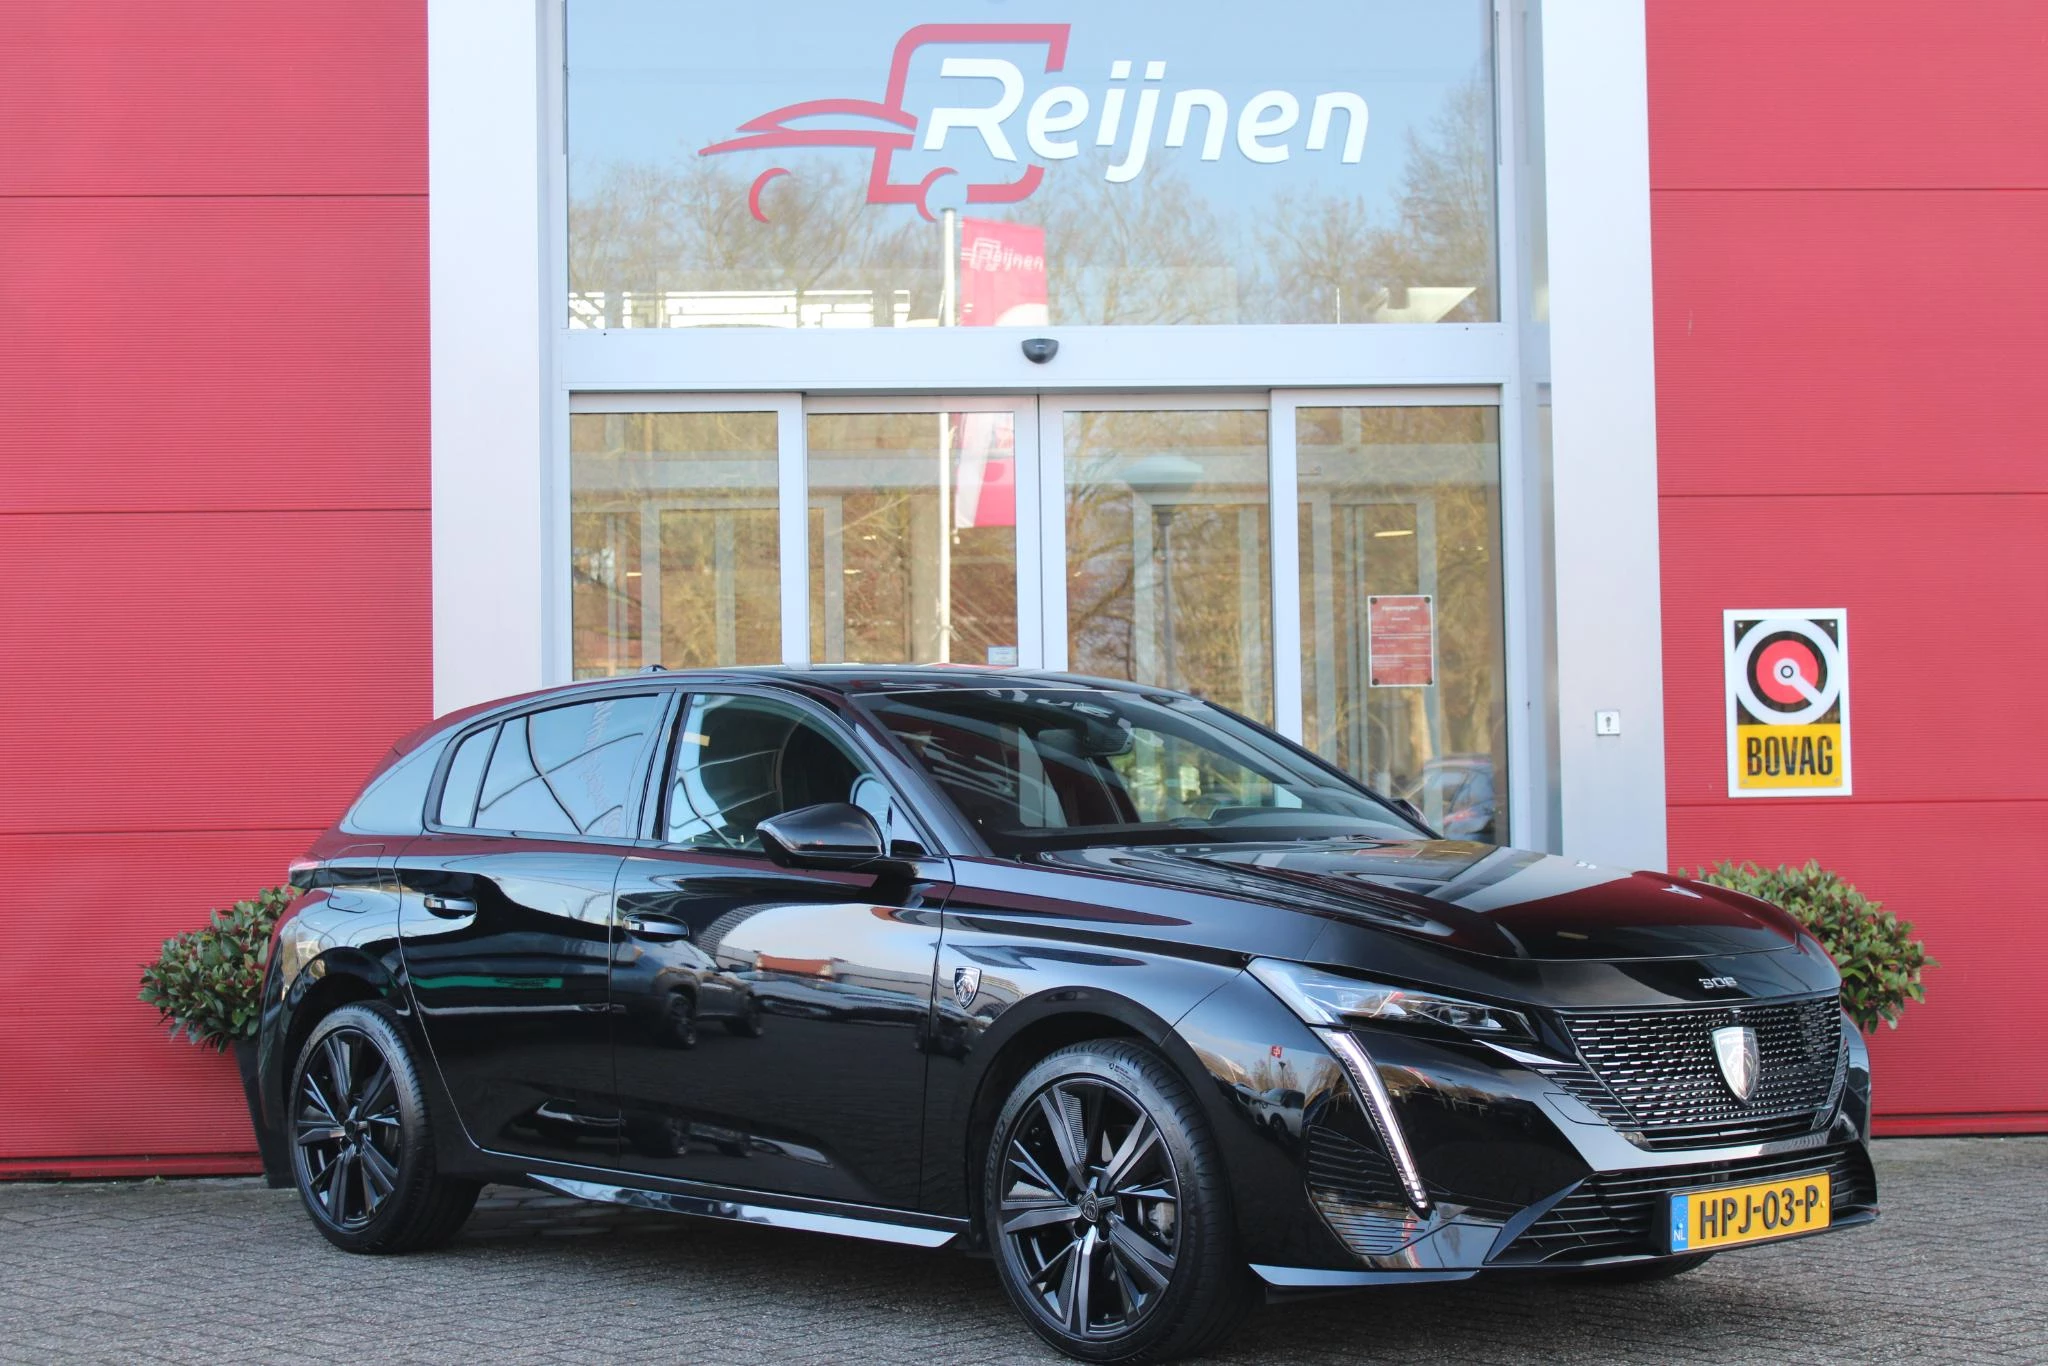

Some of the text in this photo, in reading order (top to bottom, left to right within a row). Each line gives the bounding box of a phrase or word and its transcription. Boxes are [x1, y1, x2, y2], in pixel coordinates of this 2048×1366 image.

[923, 57, 1369, 183] Reijnen
[1746, 735, 1833, 777] BOVAG
[1698, 976, 1738, 990] 308
[1700, 1185, 1820, 1240] HPJ-03-P
[1673, 1230, 1687, 1242] NL
